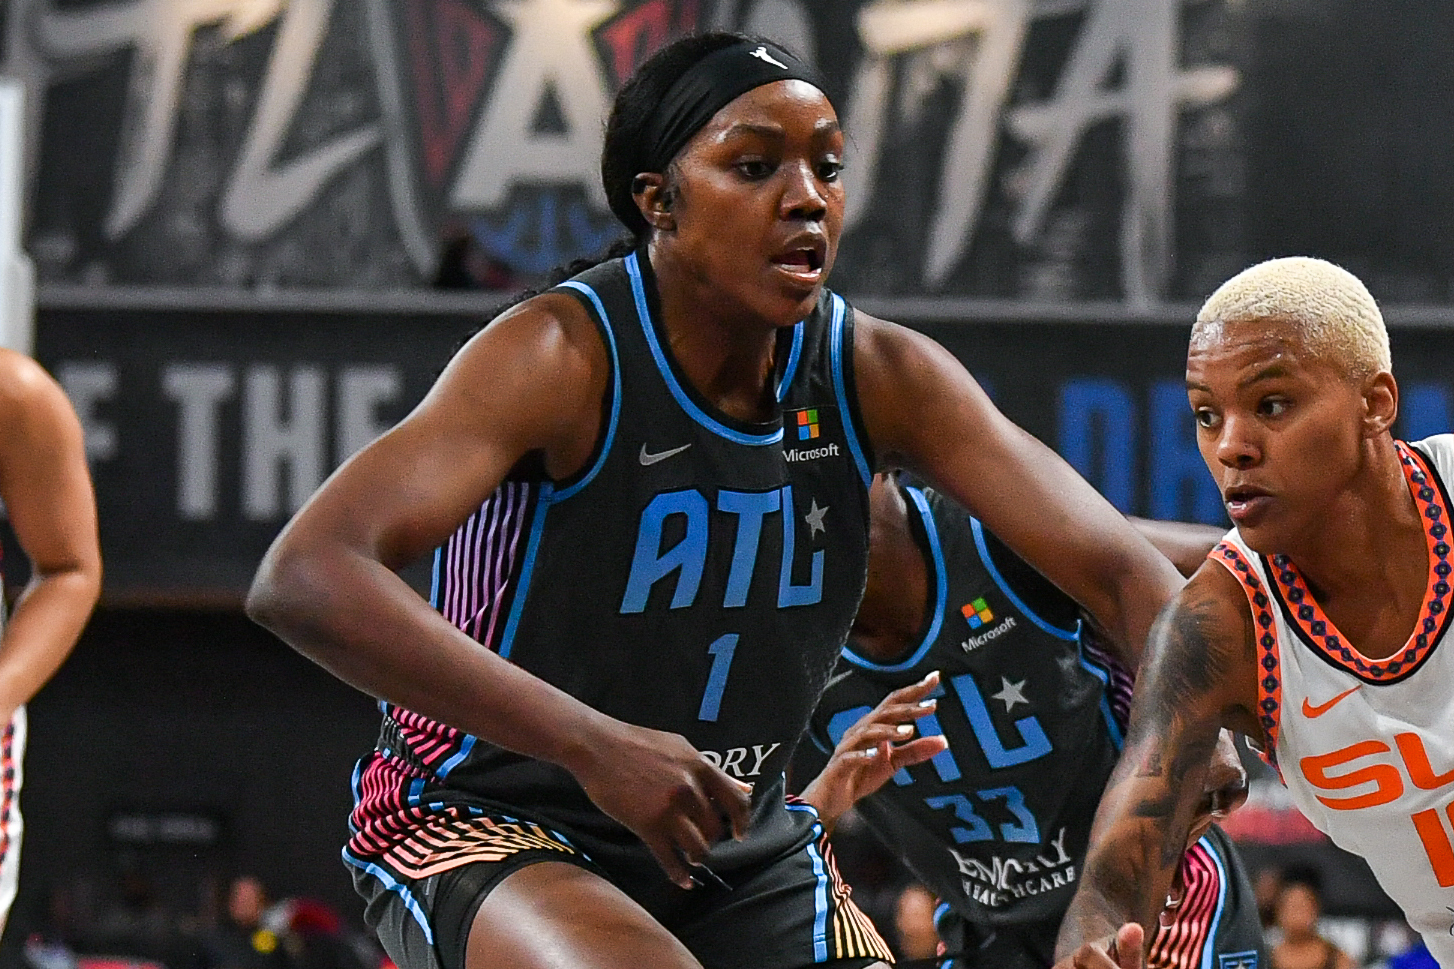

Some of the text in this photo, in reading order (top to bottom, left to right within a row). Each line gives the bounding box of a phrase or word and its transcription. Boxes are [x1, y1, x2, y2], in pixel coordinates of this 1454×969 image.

[160, 362, 397, 522] THE
[782, 442, 840, 462] Microsoft
[620, 485, 825, 614] ATL
[961, 616, 1017, 653] Microsoft
[698, 633, 740, 722] 1
[827, 673, 1053, 786] TL
[924, 786, 1041, 845] 33
[962, 865, 1076, 907] HEALHCARE
